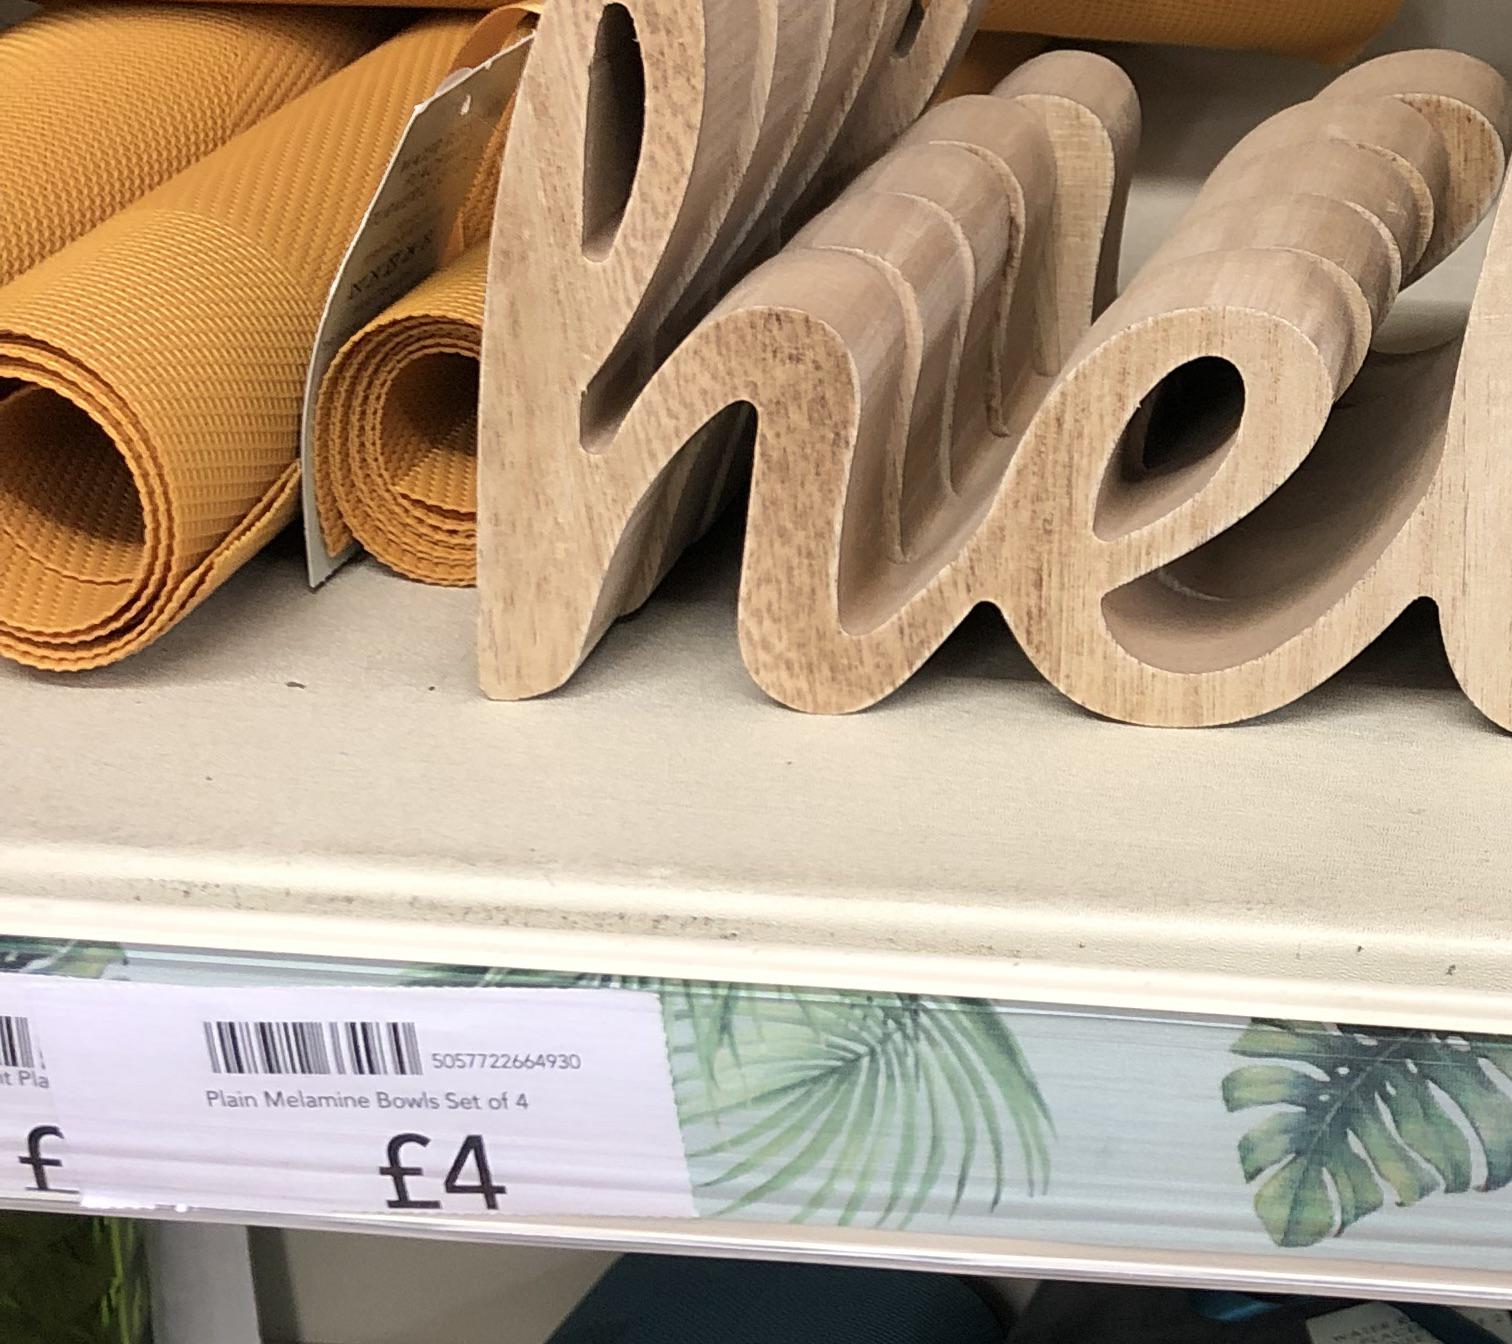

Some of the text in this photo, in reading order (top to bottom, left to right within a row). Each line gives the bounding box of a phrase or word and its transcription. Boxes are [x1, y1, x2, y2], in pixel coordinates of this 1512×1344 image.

[431, 1052, 582, 1070] 5057722664930
[206, 1089, 529, 1111] Plain Melamine Bowls Set of 4
[378, 1132, 507, 1210] £4
